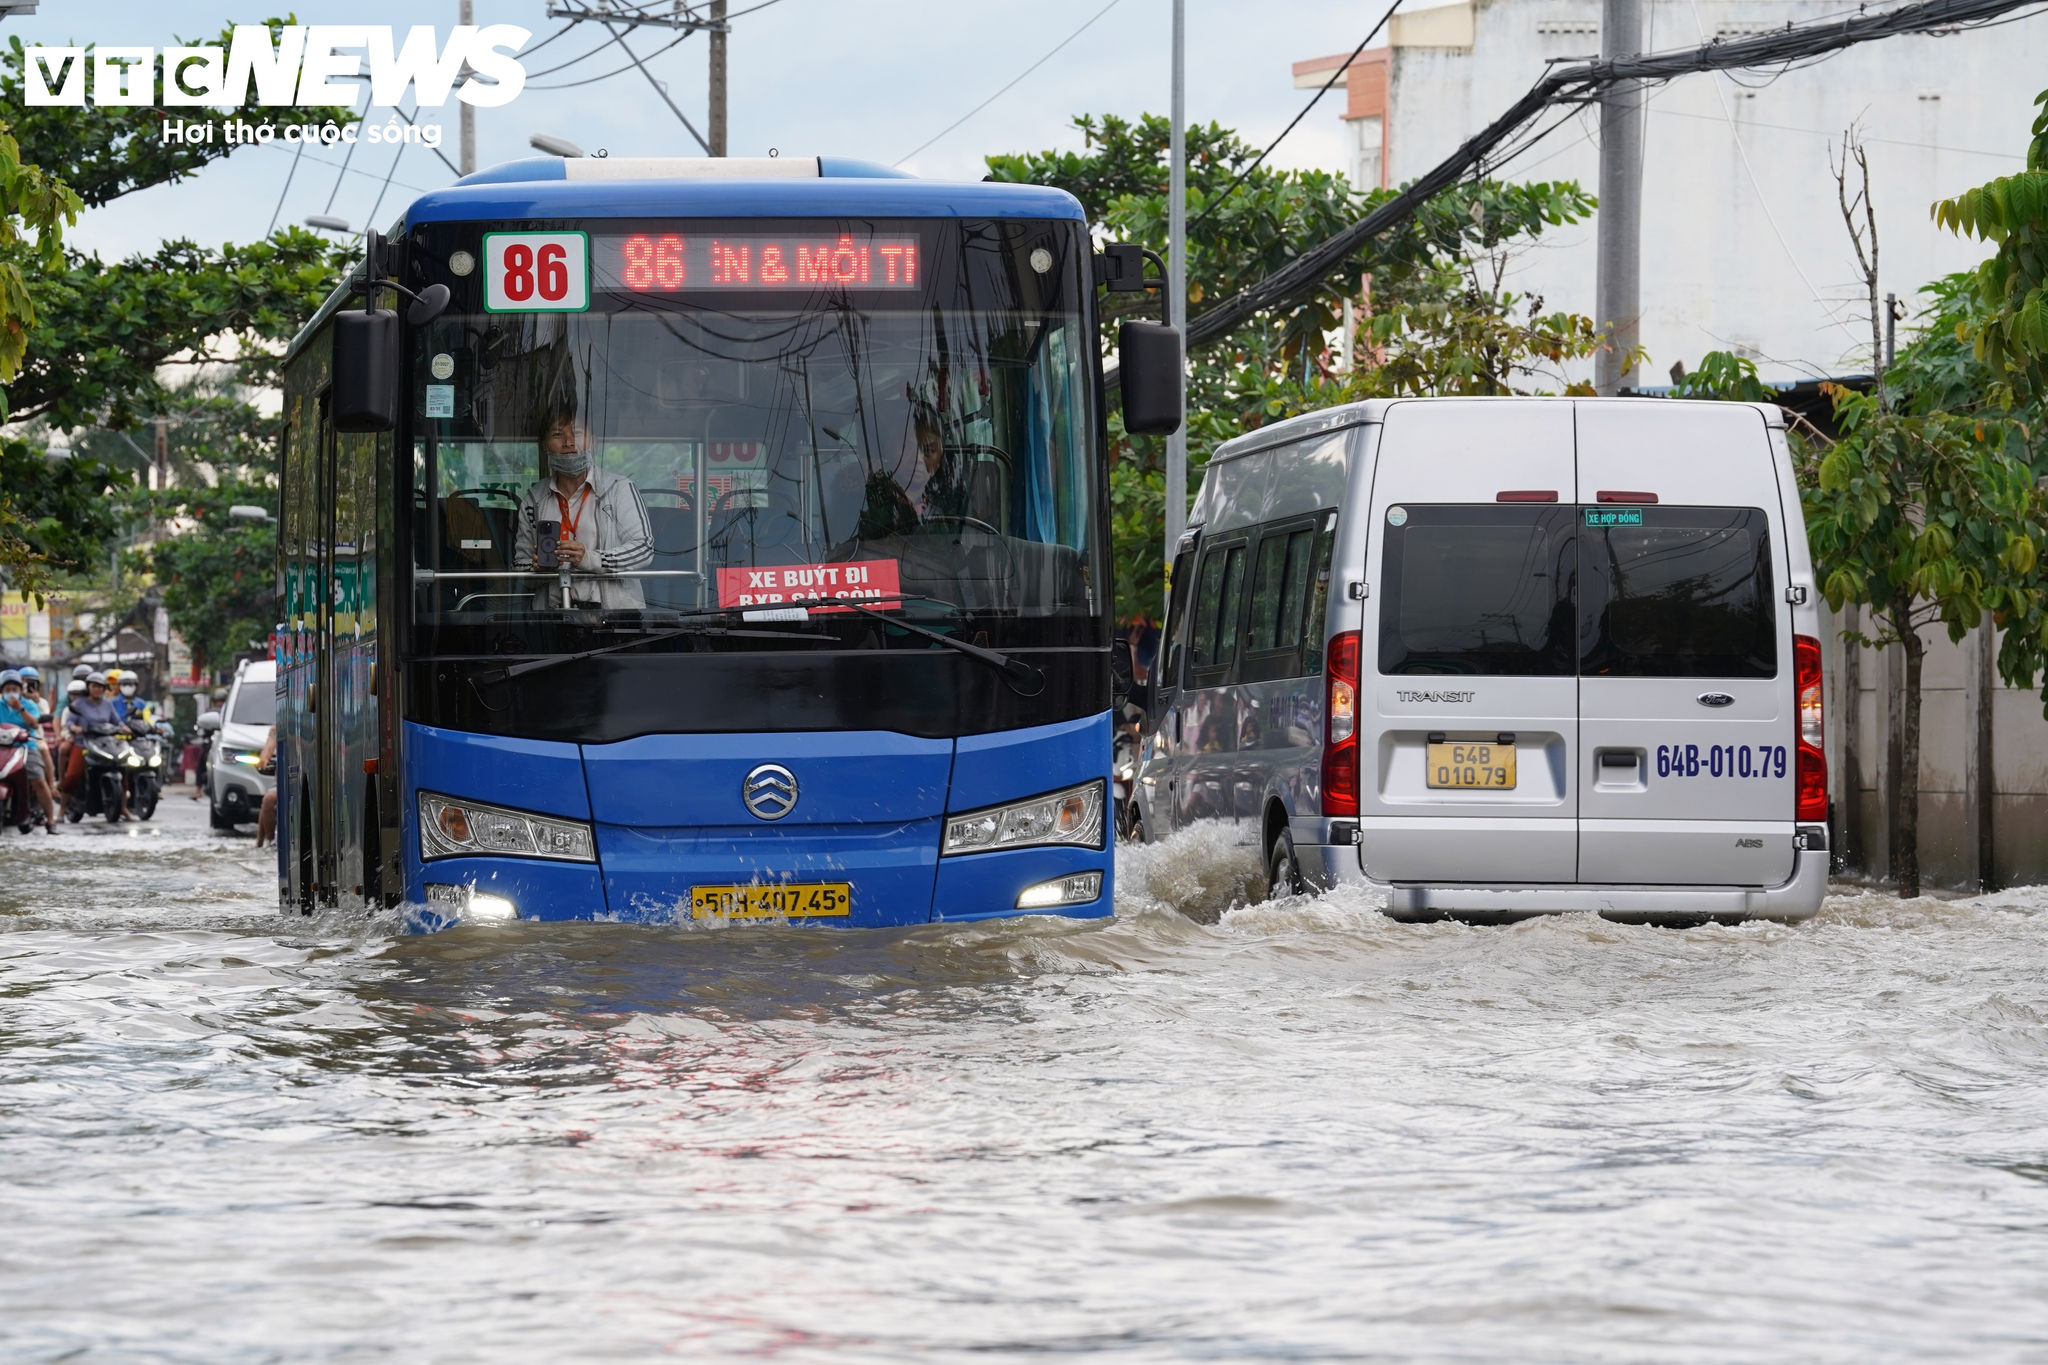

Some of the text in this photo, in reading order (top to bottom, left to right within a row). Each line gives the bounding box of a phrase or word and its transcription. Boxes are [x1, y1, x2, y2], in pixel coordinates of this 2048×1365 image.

[503, 243, 568, 301] 86
[625, 237, 685, 289] 86
[714, 241, 749, 282] N
[762, 247, 788, 282] &
[799, 238, 868, 282] MÔI
[1589, 514, 1599, 523] XE
[748, 565, 868, 588] XE BUÝT ĐI
[1397, 690, 1475, 702] TRANSIT
[1453, 746, 1490, 764] 64B
[1657, 744, 1787, 779] 64B-010.79
[1438, 766, 1506, 785] 010.79
[1735, 838, 1763, 848] ABS
